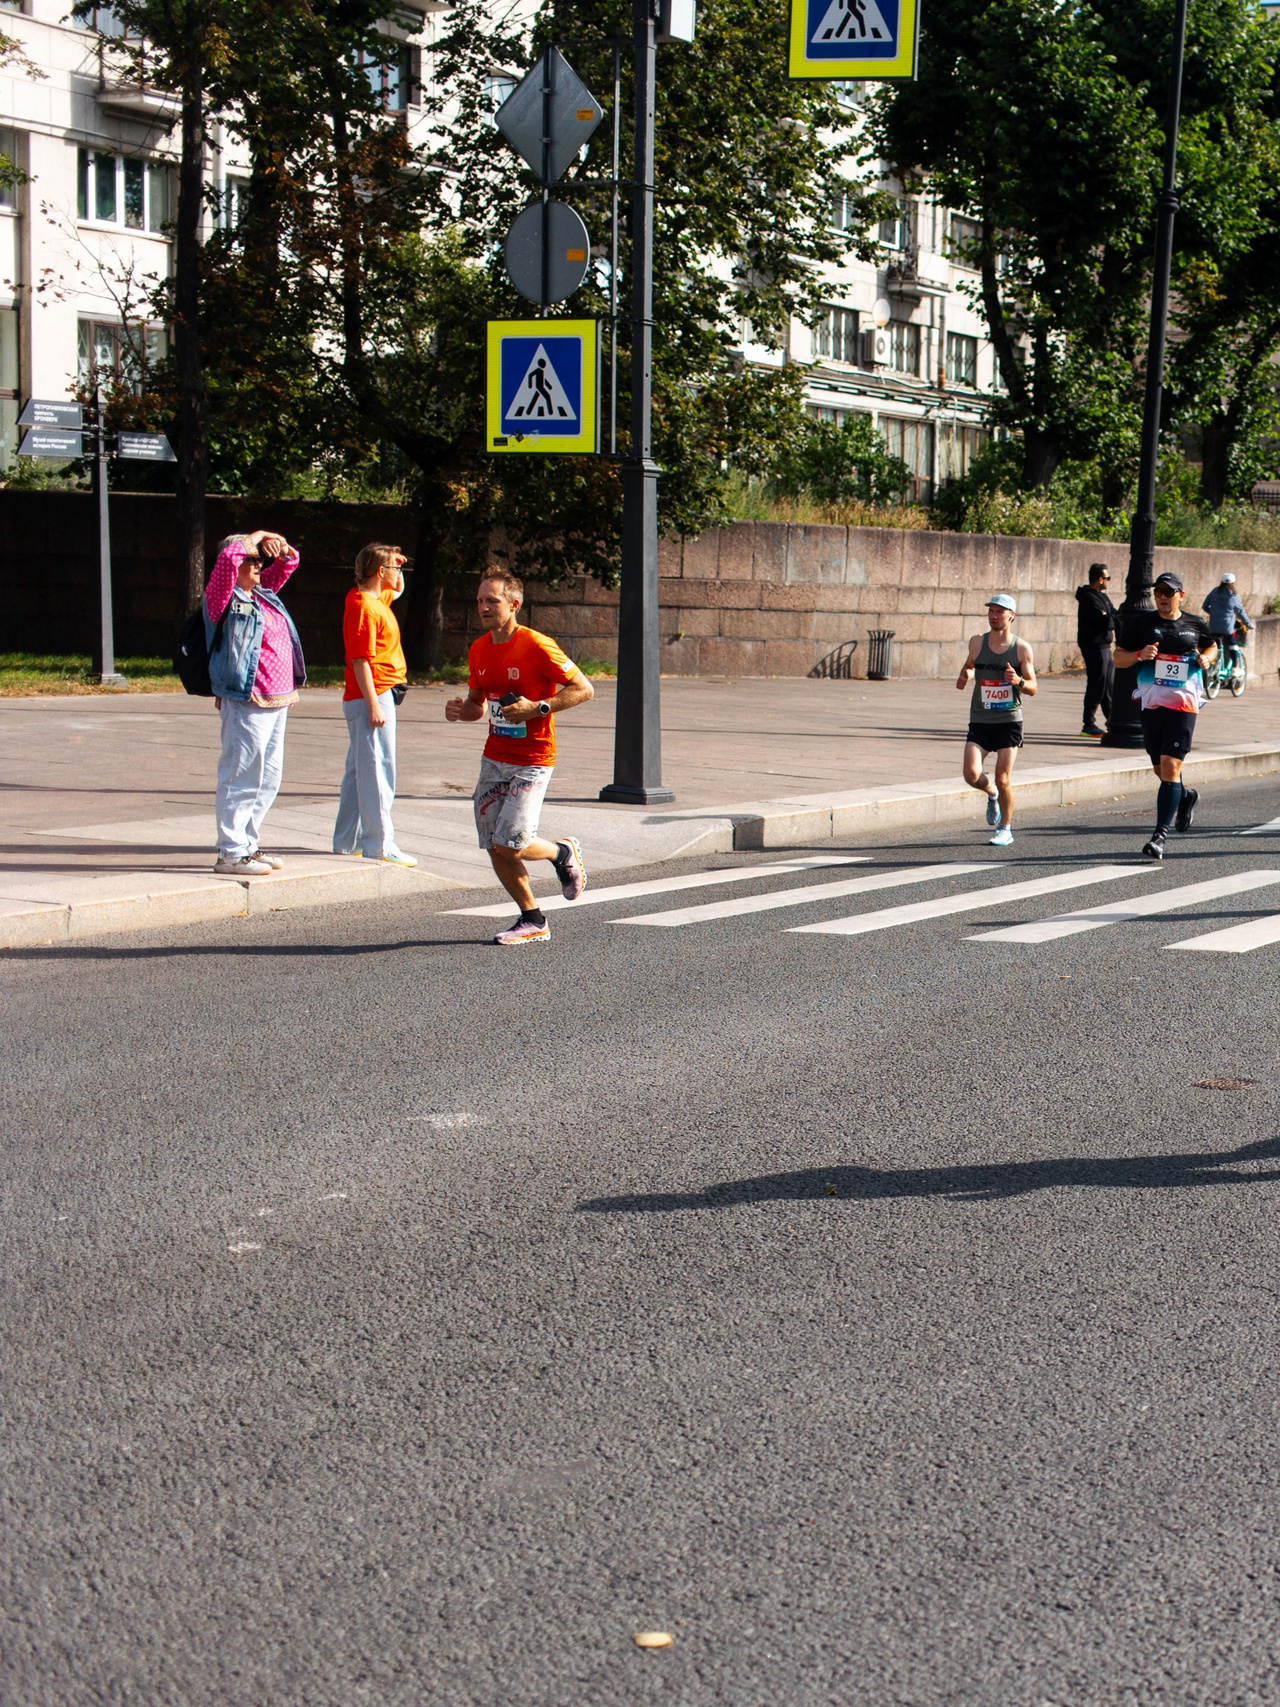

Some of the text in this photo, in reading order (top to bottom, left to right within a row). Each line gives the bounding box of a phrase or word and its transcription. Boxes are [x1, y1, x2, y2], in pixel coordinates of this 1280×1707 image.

[507, 667, 520, 680] 10
[1166, 664, 1179, 674] 93
[986, 690, 1009, 699] 7400
